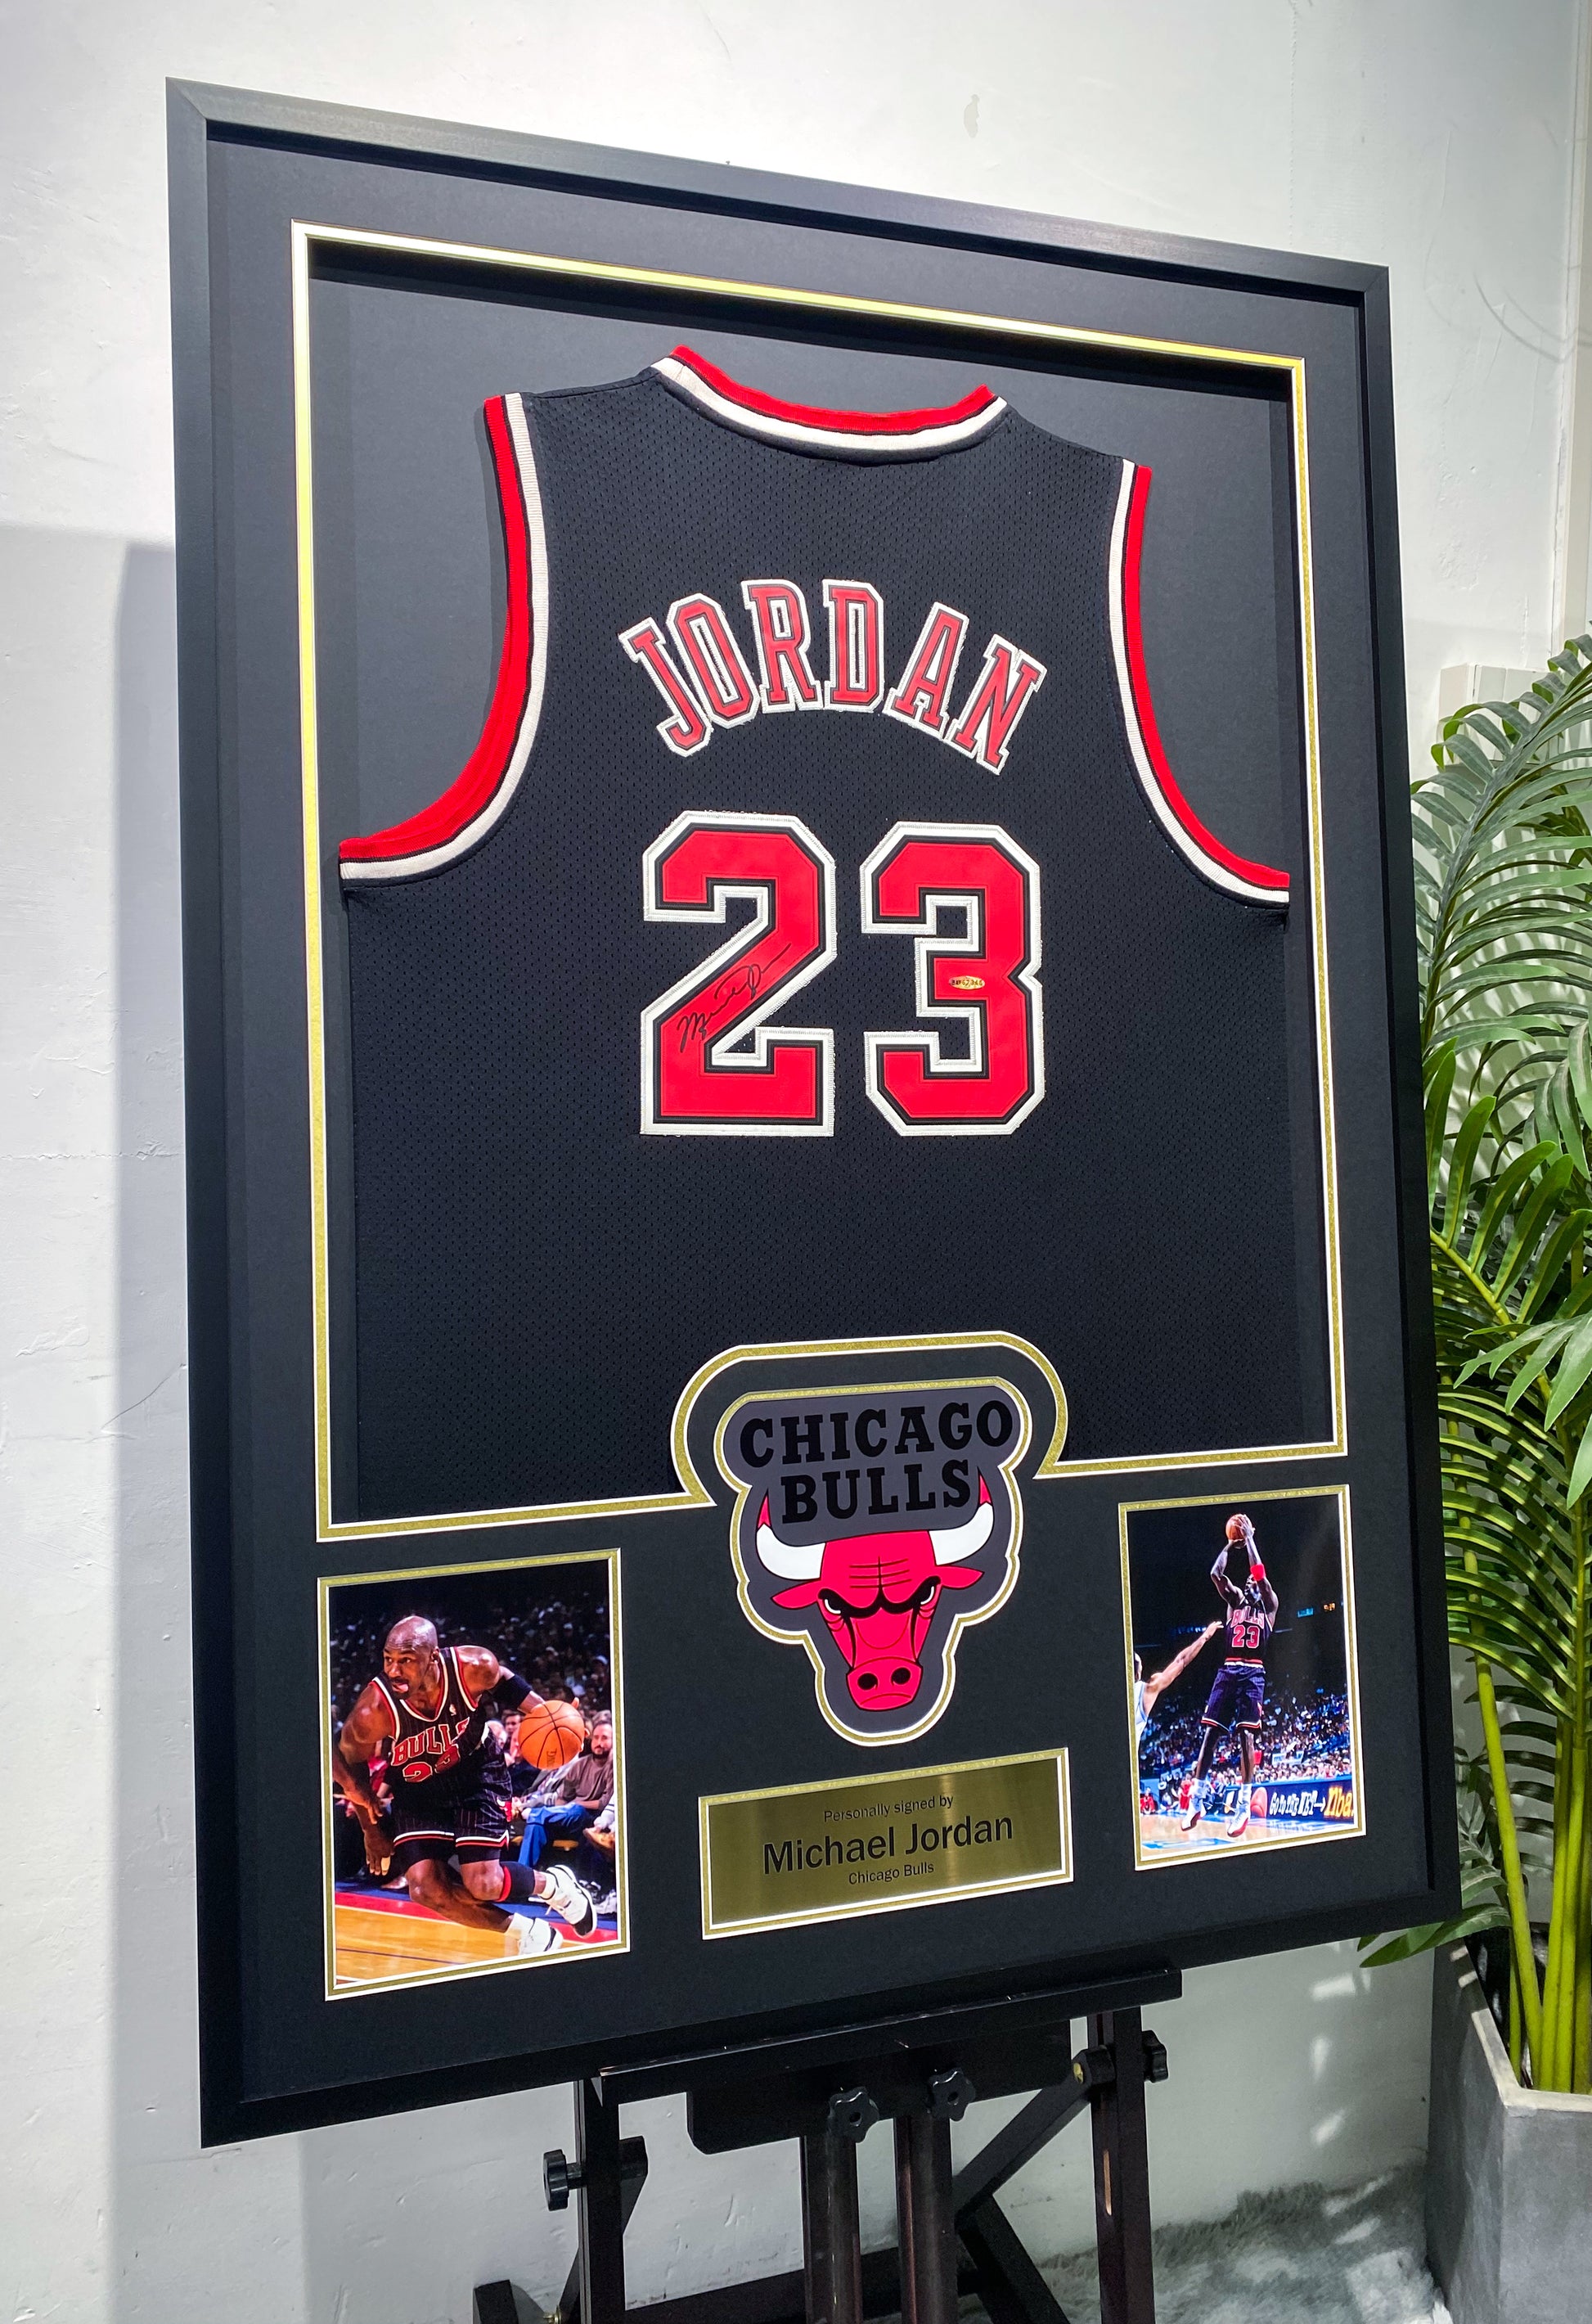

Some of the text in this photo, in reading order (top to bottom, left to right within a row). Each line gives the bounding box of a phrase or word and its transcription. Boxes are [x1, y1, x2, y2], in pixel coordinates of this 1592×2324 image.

[618, 579, 1047, 775] JORDAN
[640, 810, 1046, 1136] 23
[740, 1400, 1013, 1468] CHICAGO
[780, 1459, 970, 1524] BULLS
[1231, 1624, 1260, 1648] 23
[824, 1795, 954, 1822] Personally signed by
[763, 1815, 1013, 1875] Michael Jordan
[848, 1862, 934, 1885] Chicago Bulls
